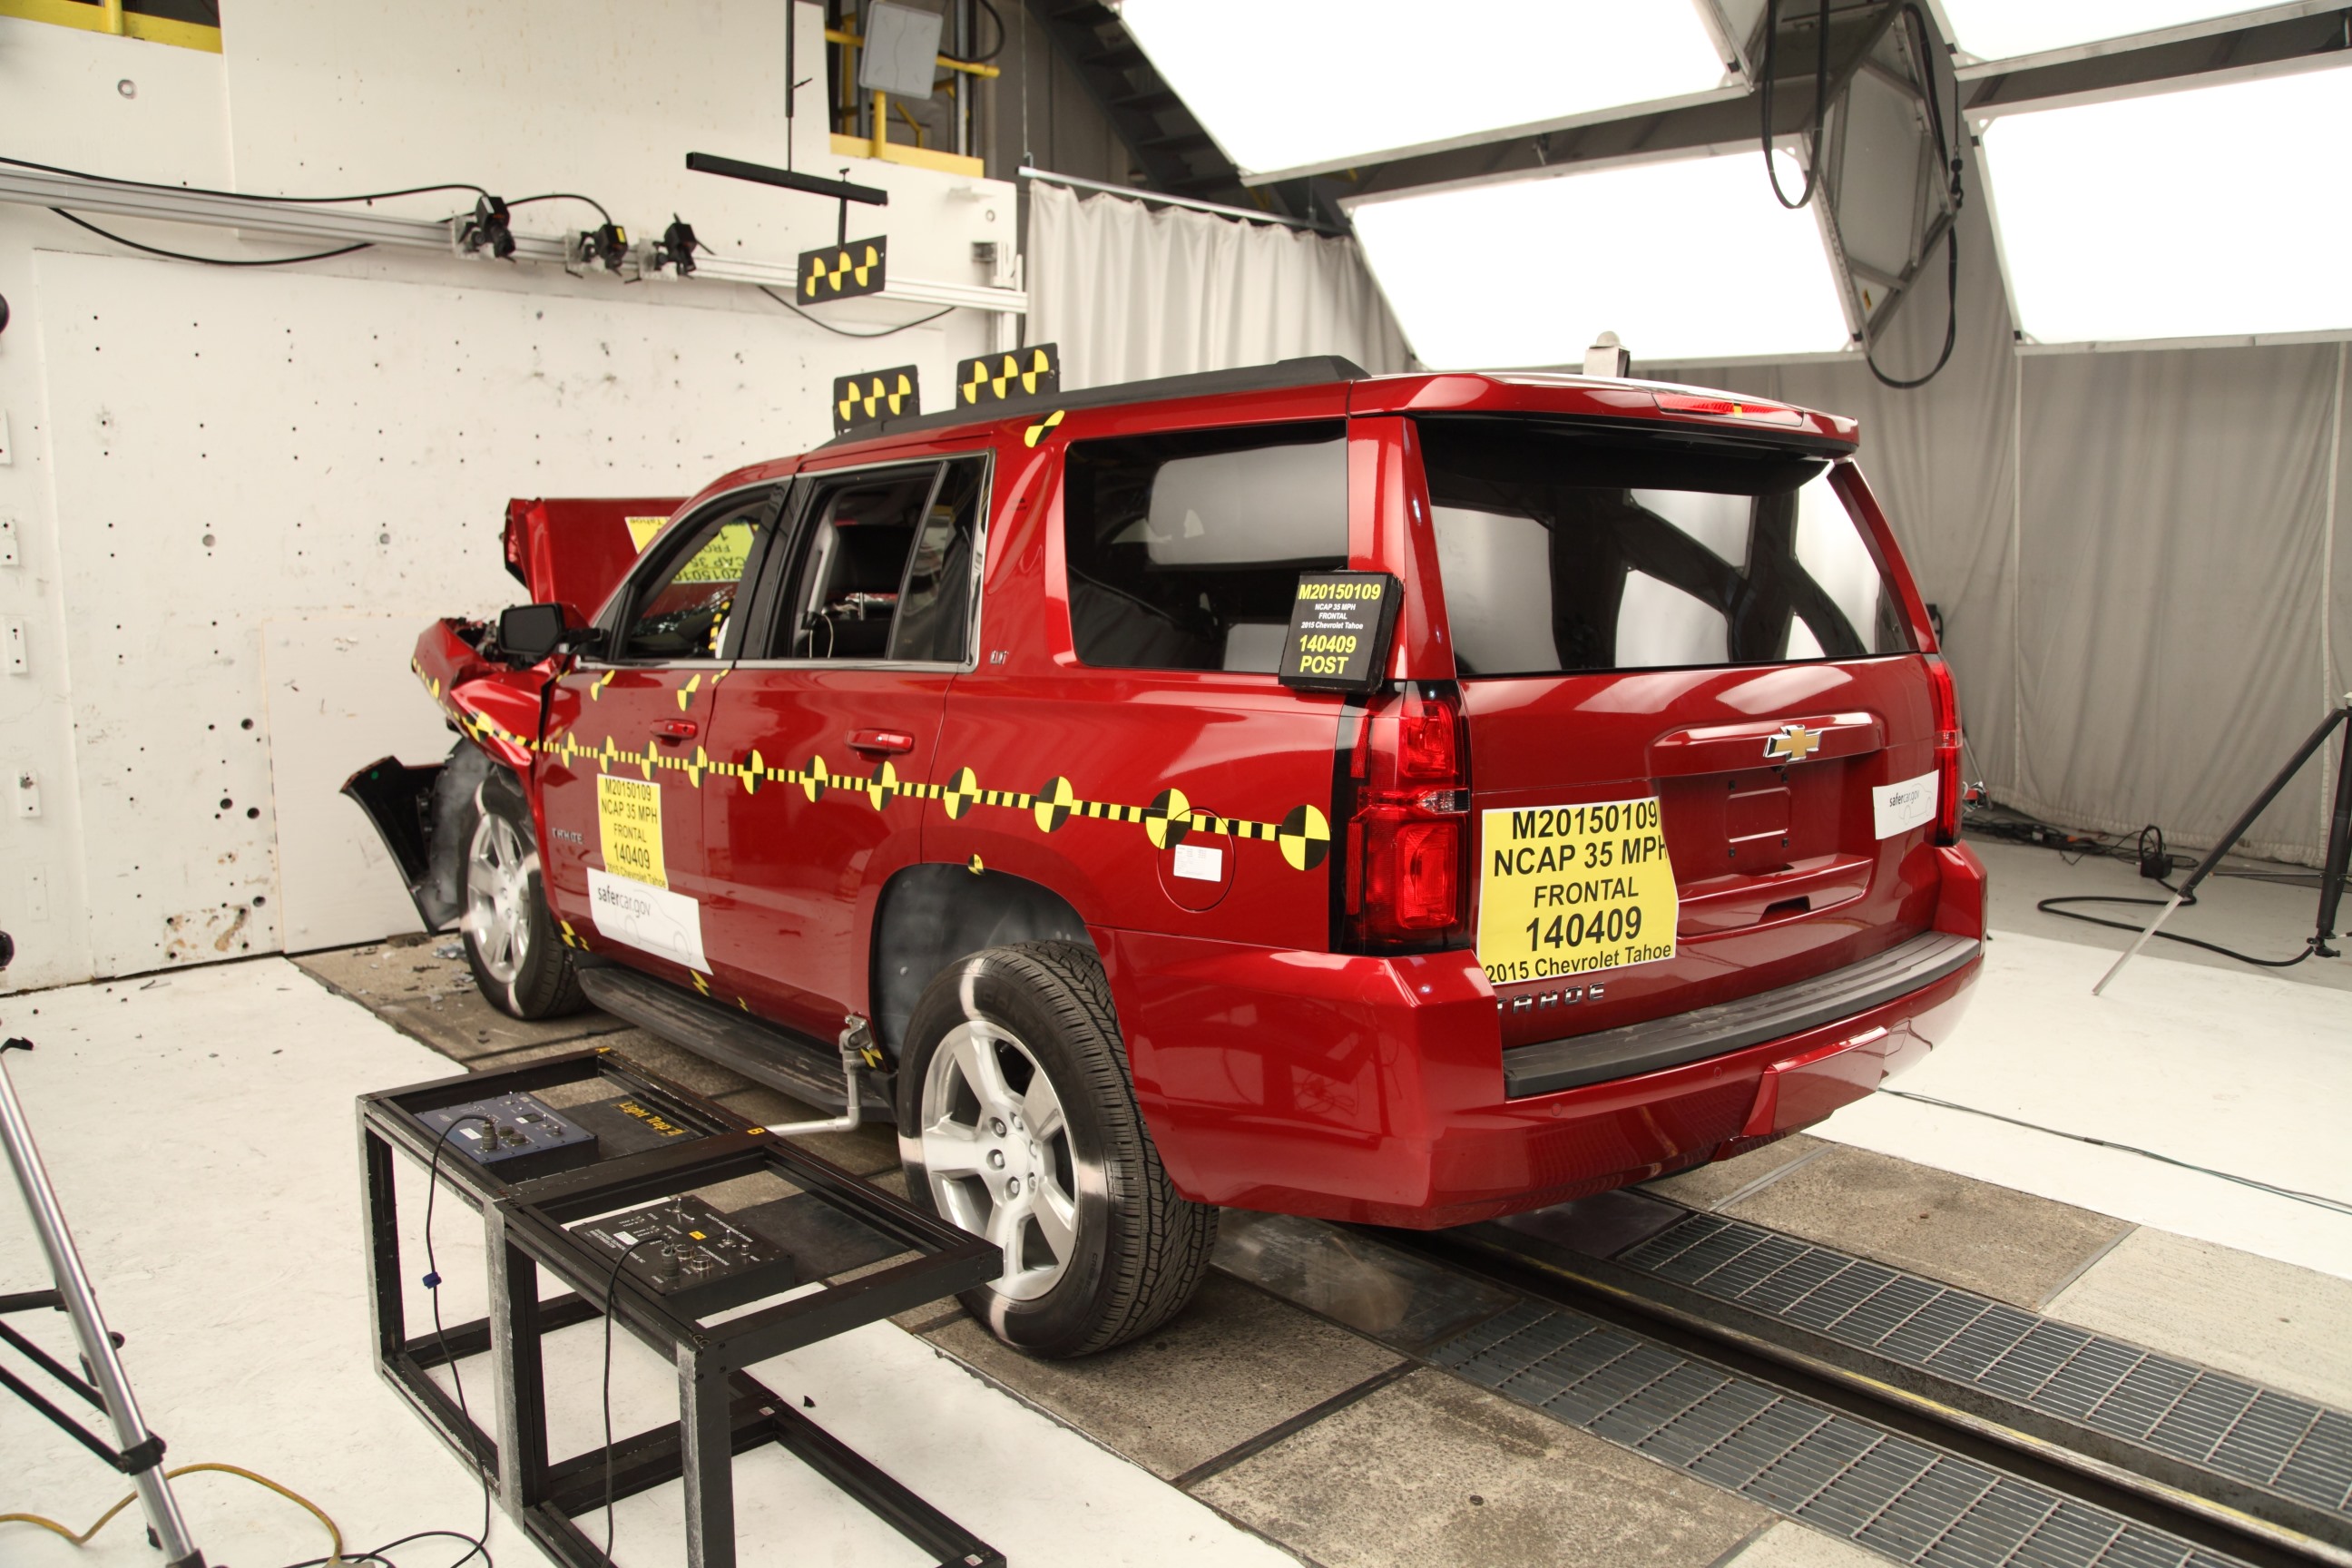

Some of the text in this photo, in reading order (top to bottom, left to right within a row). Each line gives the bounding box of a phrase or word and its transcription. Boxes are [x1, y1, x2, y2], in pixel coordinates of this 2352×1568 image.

[714, 556, 746, 567] CAP
[1298, 583, 1381, 600] M20150109
[1345, 622, 1364, 630] Tahoe
[1299, 634, 1357, 653] 140409
[1299, 655, 1348, 674] POST
[605, 778, 652, 801] M20150109
[1889, 790, 1920, 808] safercar.gov
[602, 798, 658, 825] NCAP 35 MPH
[1512, 799, 1658, 840] M20150109
[613, 823, 647, 843] FRONTAL
[613, 842, 651, 870] 140409
[1494, 835, 1668, 877] NCAP 35 MPH
[648, 873, 666, 888] Tahoe
[1534, 876, 1640, 908] FRONTAL
[598, 885, 651, 918] safercar.gov
[1525, 906, 1642, 952] 140409
[1485, 944, 1671, 984] 2015 Chevrolet Tahoe
[619, 1100, 651, 1117] Light
[646, 1115, 671, 1131] Trap
[747, 1127, 766, 1135] B
